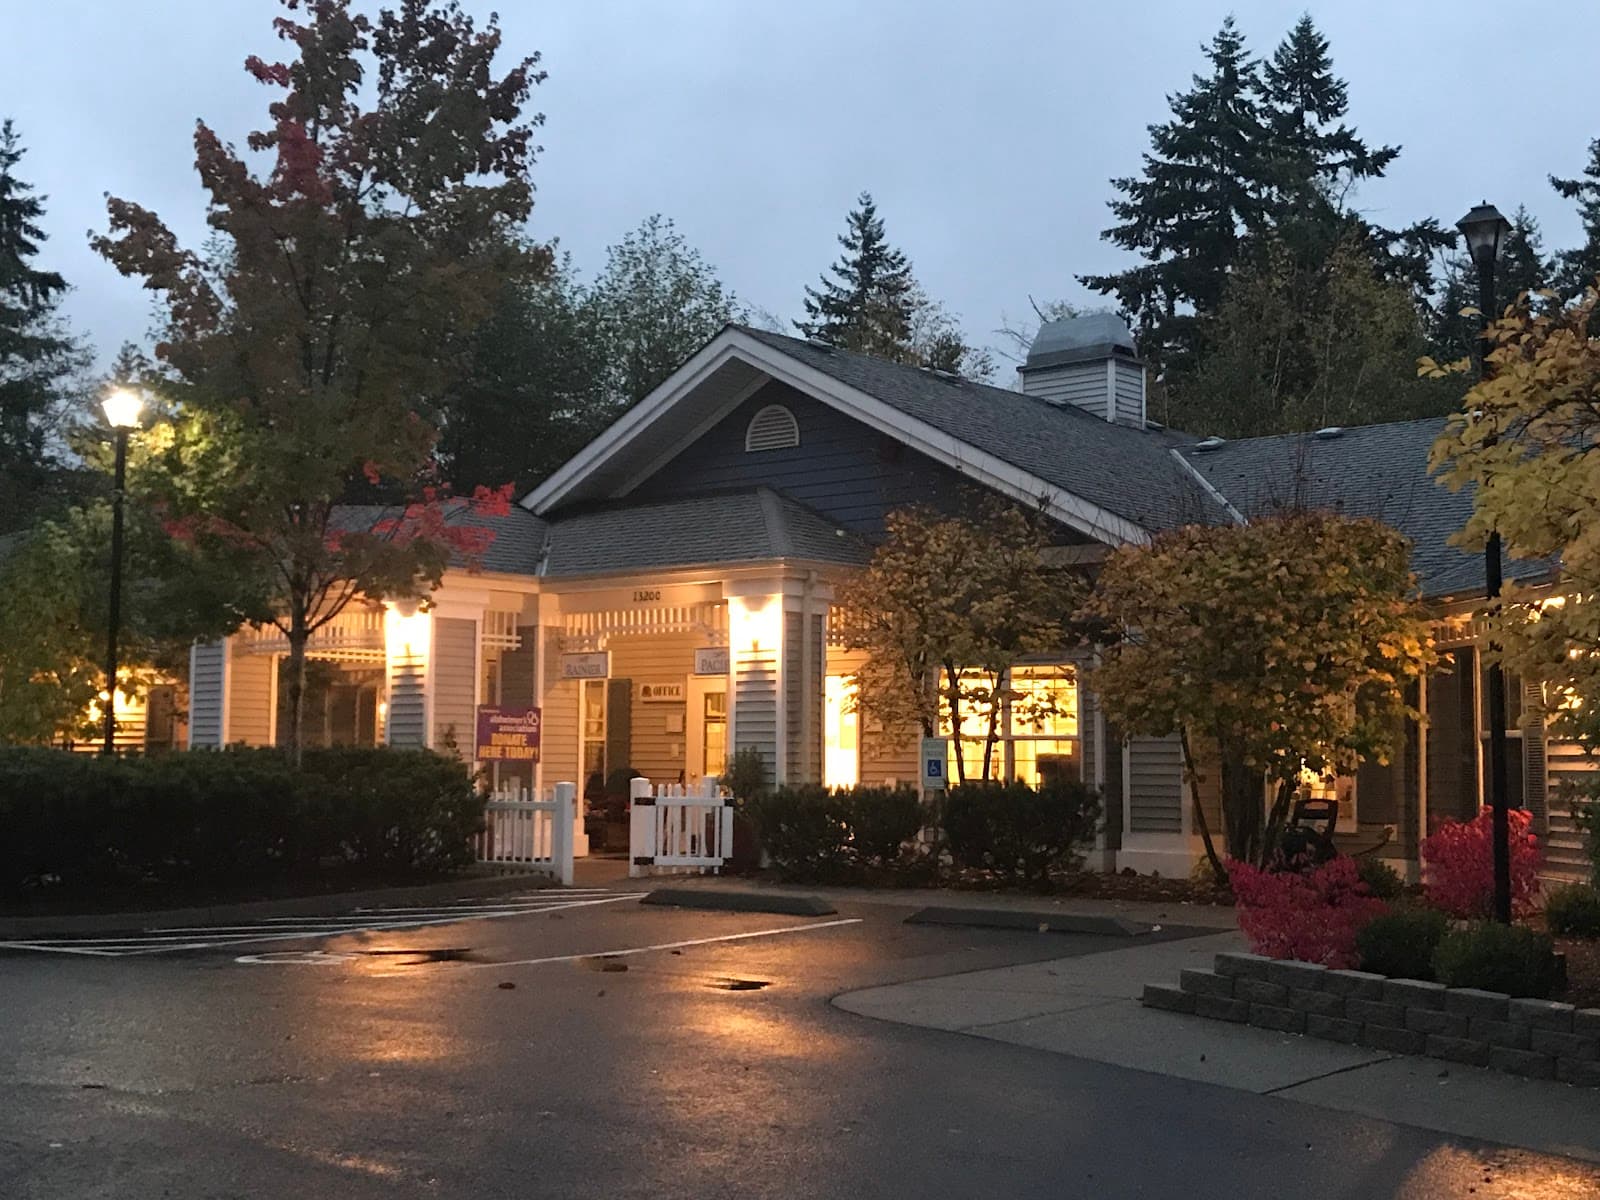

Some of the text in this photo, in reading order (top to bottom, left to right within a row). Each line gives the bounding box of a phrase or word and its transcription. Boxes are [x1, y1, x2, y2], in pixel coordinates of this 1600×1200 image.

[632, 590, 662, 602] 13200
[653, 686, 681, 697] OFFICE
[491, 733, 527, 746] DONATE
[479, 746, 502, 758] HERE
